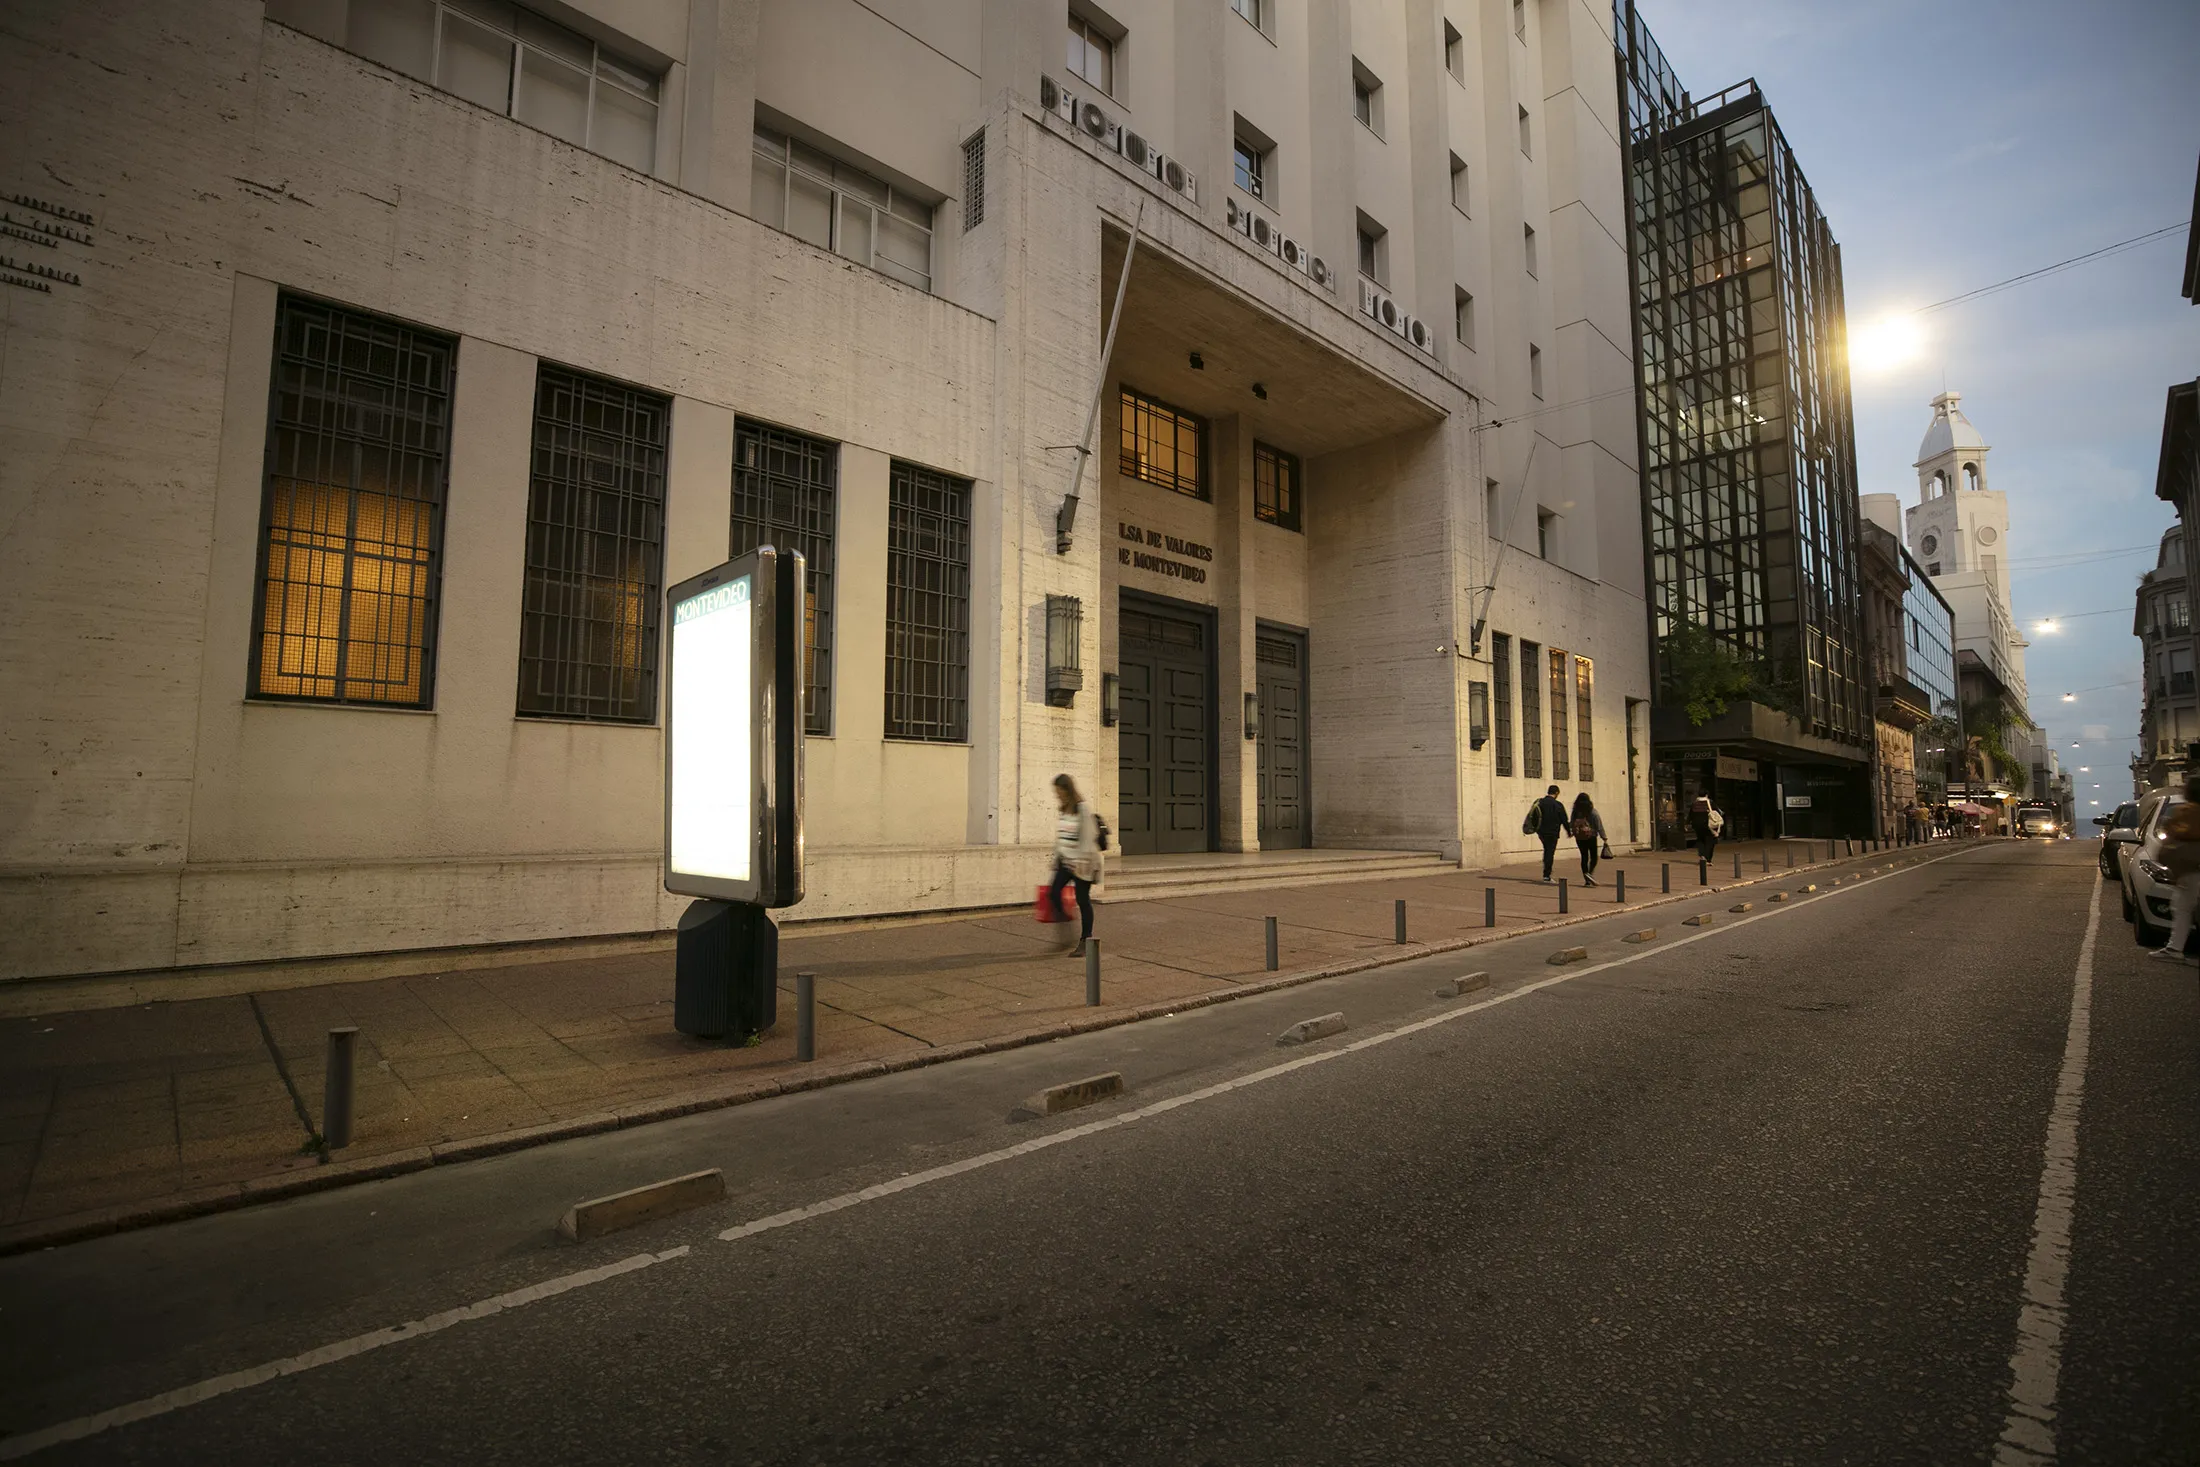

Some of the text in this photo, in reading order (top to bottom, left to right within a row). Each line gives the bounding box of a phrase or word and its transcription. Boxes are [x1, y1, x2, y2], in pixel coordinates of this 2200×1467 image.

[1119, 523, 1213, 562] LSA DE VALORES
[1134, 551, 1206, 584] MONTEVIDEO
[675, 581, 747, 624] MONTEVIDEO
